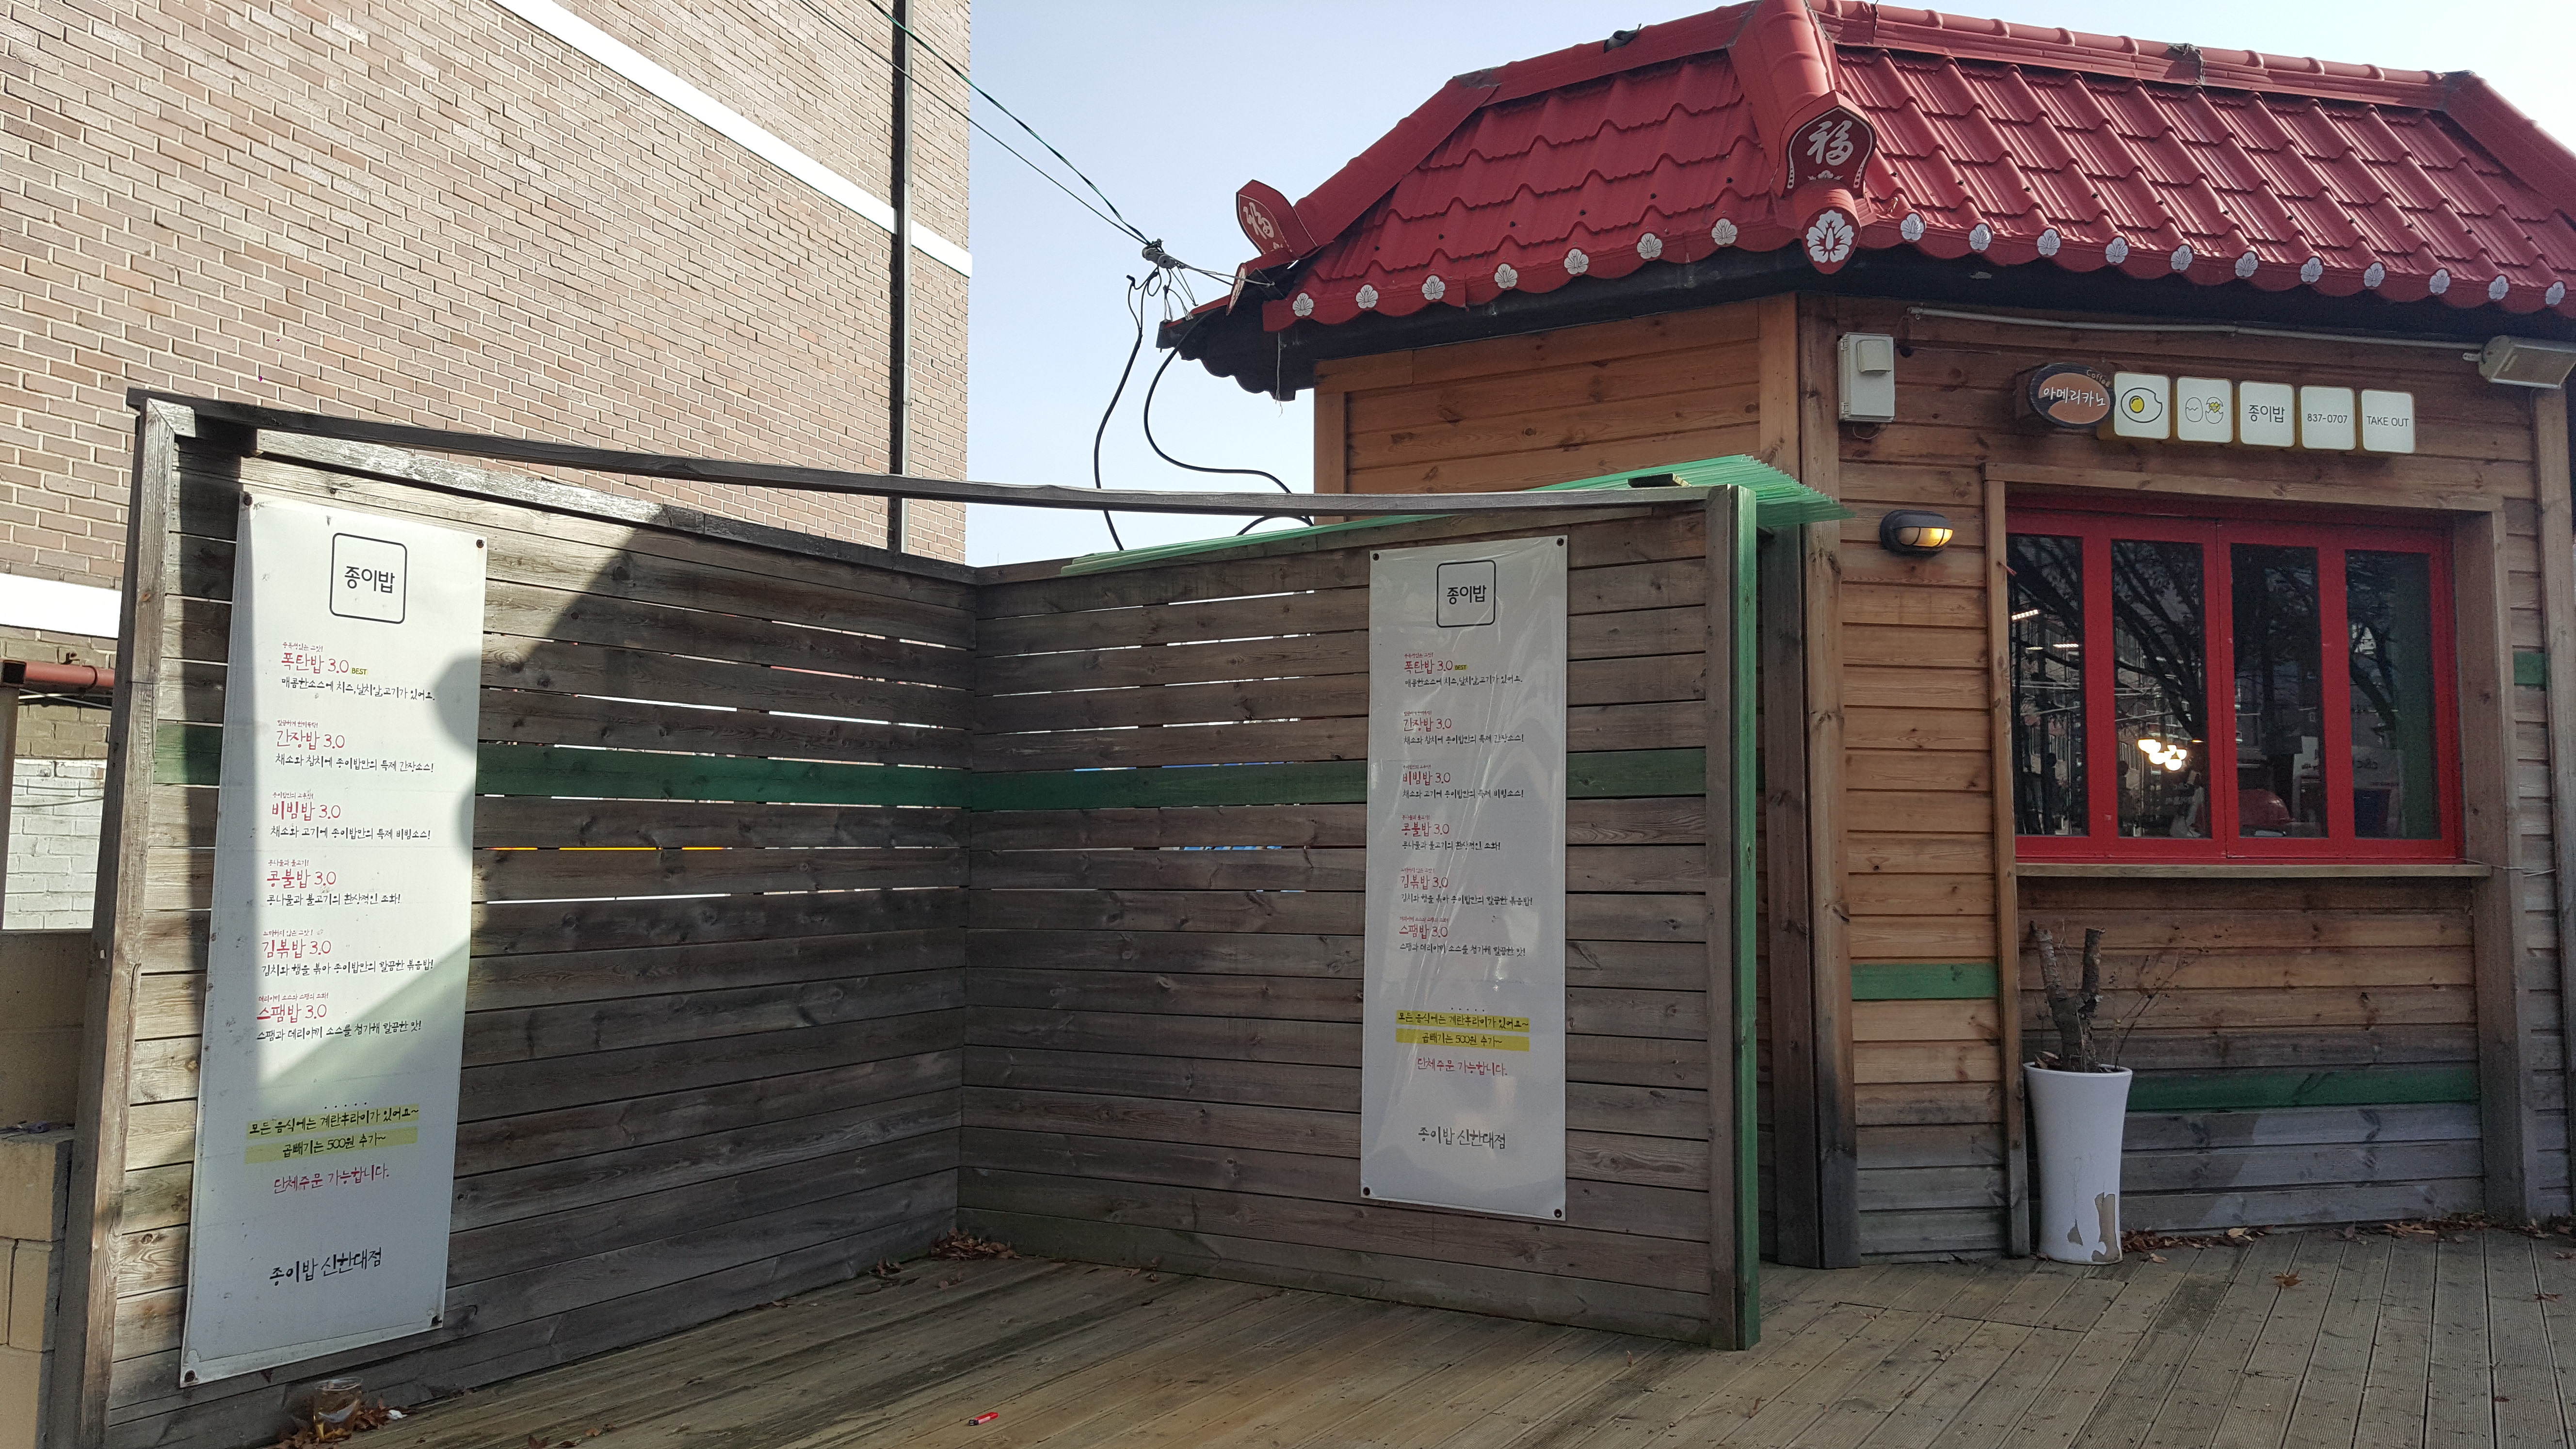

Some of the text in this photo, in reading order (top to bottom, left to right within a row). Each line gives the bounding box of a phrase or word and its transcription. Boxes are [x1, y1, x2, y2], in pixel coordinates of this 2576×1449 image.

[2086, 369, 2111, 387] Coffee
[2044, 386, 2106, 407] 아메리카노
[2248, 403, 2285, 423] 종이밥
[2306, 412, 2348, 425] 837-0707
[2367, 416, 2410, 428] TAKE OUT
[344, 565, 395, 594] 종이밥
[1447, 585, 1487, 605] 종이밥
[281, 652, 324, 674] 폭탄밥
[328, 659, 349, 674] 3.0
[1404, 660, 1434, 674] 폭탄밥
[1437, 660, 1453, 672] 3.0
[282, 676, 334, 692] 매콤한소스에
[411, 688, 435, 701] 있어요.
[1405, 678, 1442, 688] 매콤한소스에
[1501, 676, 1522, 684] 있어요.
[1403, 718, 1452, 732] 간장밥 3.0
[276, 729, 345, 750] 간장밥 3.0
[1404, 736, 1423, 745] 채소와
[1479, 734, 1492, 743] 특제
[1494, 734, 1524, 743] 간장소스!
[275, 753, 434, 773] 채소와 참치에 종이밥만의 특제 간장소스!
[1403, 771, 1450, 785] 비빔밥 3.0
[1402, 789, 1422, 798] 채소와
[1424, 789, 1442, 798] 고기에
[1494, 789, 1523, 798] 비빔소스!
[272, 801, 341, 821] 비빔밥 3.0
[271, 825, 431, 840] 채소와 고기에 종이밥만의 특제 비빔소스!
[1401, 822, 1449, 837] 콩불밥 3.0
[1402, 841, 1427, 850] 콩나물과
[1429, 841, 1453, 850] 불고기의
[1455, 841, 1482, 850] 환상적인
[267, 869, 336, 888] 콩불밥 3.0
[1401, 875, 1449, 890] 김볶밥 3.0
[267, 893, 401, 906] 콩나물과 불고기의 환상적인 조화!
[1401, 894, 1532, 906] 김치와 햄을 볶아 종이밥만의 깔끔한 볶음밥!
[1400, 924, 1448, 939] 스팸밥 3.0
[262, 939, 331, 959] 김볶밥 3.0
[1400, 942, 1526, 957] 스팸과 데리야끼 소스를 첨가해 깔끔한 맛!
[262, 958, 434, 977] 김치와 햄을 볶아 종이밥만의 깔끔한 볶음밥!
[257, 1003, 327, 1024] 스팸밥 3.0
[1398, 1012, 1413, 1021] 모든
[1416, 1013, 1446, 1024] 음식에는
[1449, 1014, 1496, 1027] 계란후라이가
[257, 1020, 421, 1042] 스팸과 데리야끼 소스를 첨가해 깔끔한 맛!
[1422, 1033, 1454, 1044] 곱빼기는
[1455, 1035, 1477, 1045] 500원
[1417, 1057, 1507, 1076] 단체주문 가능합니다.
[249, 1107, 419, 1135] 모든 음식에는 계란후라이가 있어요~
[283, 1132, 386, 1158] 곱빼기는 500원 추가~
[1418, 1127, 1505, 1148] 종이밥 신한대점
[274, 1163, 389, 1194] 단체주문 가능합니다.
[270, 1247, 382, 1286] 종이밥 신한대점
